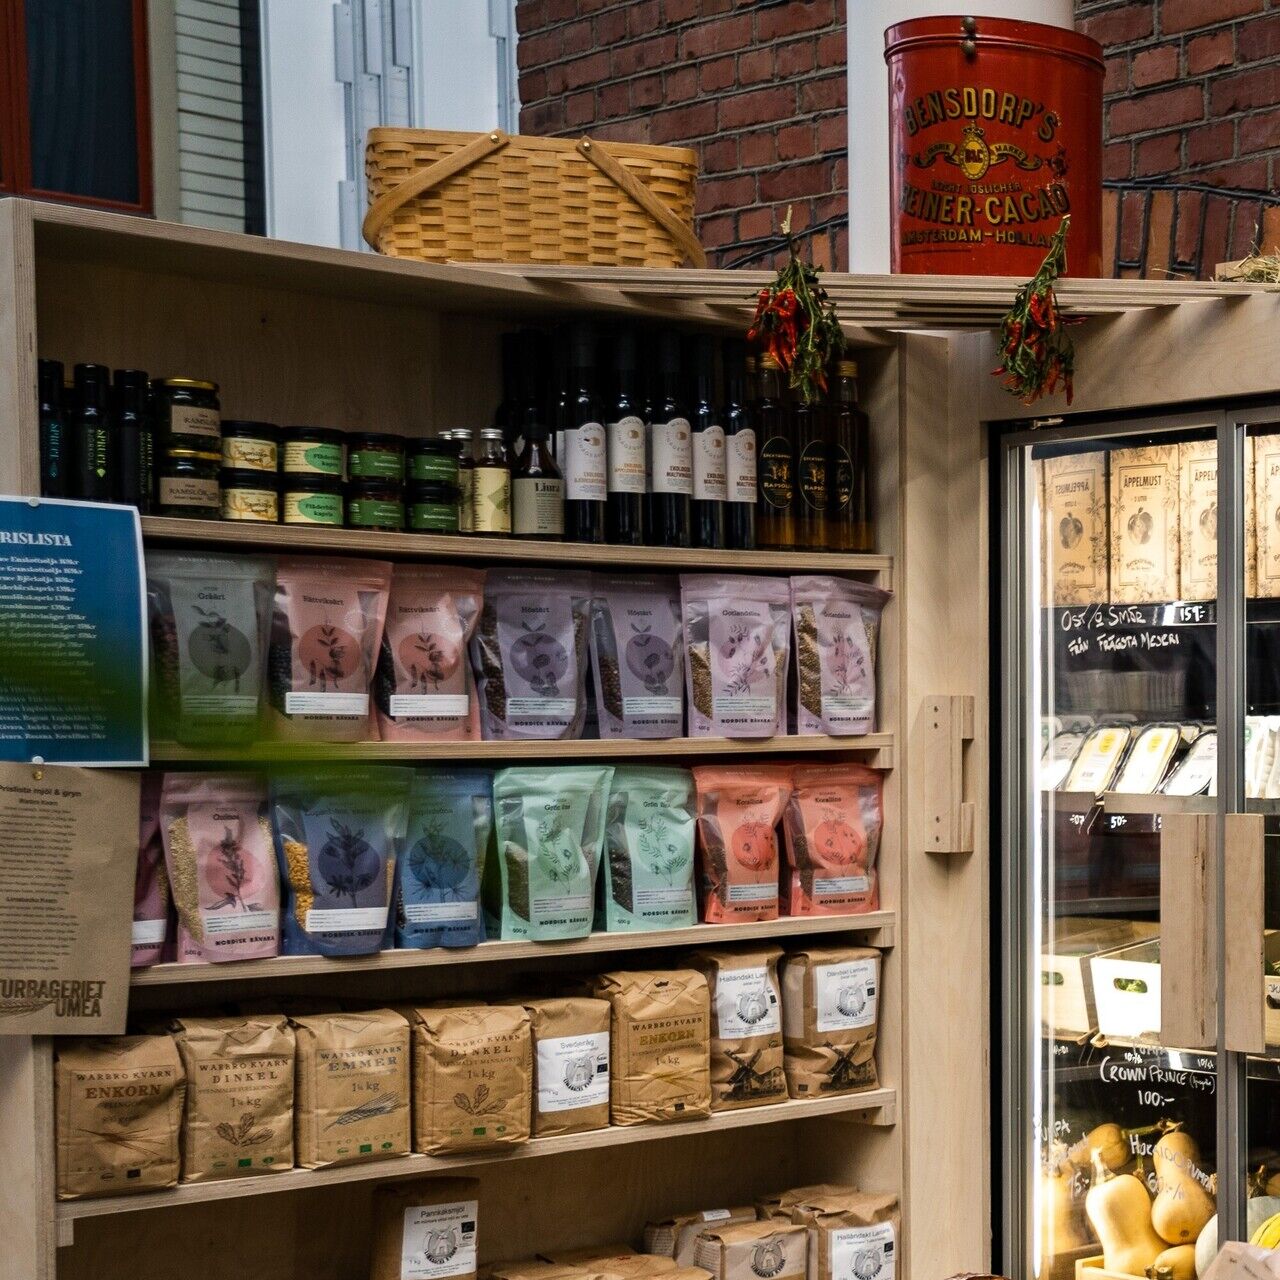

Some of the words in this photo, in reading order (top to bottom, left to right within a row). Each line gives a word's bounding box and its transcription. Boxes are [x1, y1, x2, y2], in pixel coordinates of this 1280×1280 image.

[903, 87, 1060, 143] BENSDORP'S
[1124, 474, 1162, 489] ÄPPELMUST
[0, 532, 72, 546] RISLISTA
[1061, 606, 1085, 632] OST
[0, 979, 107, 1001] URBAGERIET
[55, 991, 101, 1018] UMEÅ
[632, 1021, 671, 1031] WARBRO
[674, 1017, 703, 1026] KVARN
[487, 1034, 521, 1043] KVARN
[640, 1029, 695, 1045] ENKORN
[367, 1046, 402, 1056] KVARN
[450, 1045, 511, 1057] DINKEL
[200, 1062, 247, 1072] WARBRO
[249, 1058, 289, 1068] KVARN
[328, 1056, 398, 1071] EMMER
[1099, 1055, 1147, 1083] CROWN
[1149, 1064, 1187, 1086] PRINCE
[76, 1072, 128, 1082] WARBRO
[133, 1070, 172, 1079] KVARN
[212, 1071, 278, 1084] DINKEL
[481, 1068, 496, 1079] kg
[85, 1083, 162, 1100] ENKORN
[366, 1081, 380, 1092] kg
[246, 1097, 262, 1108] kg
